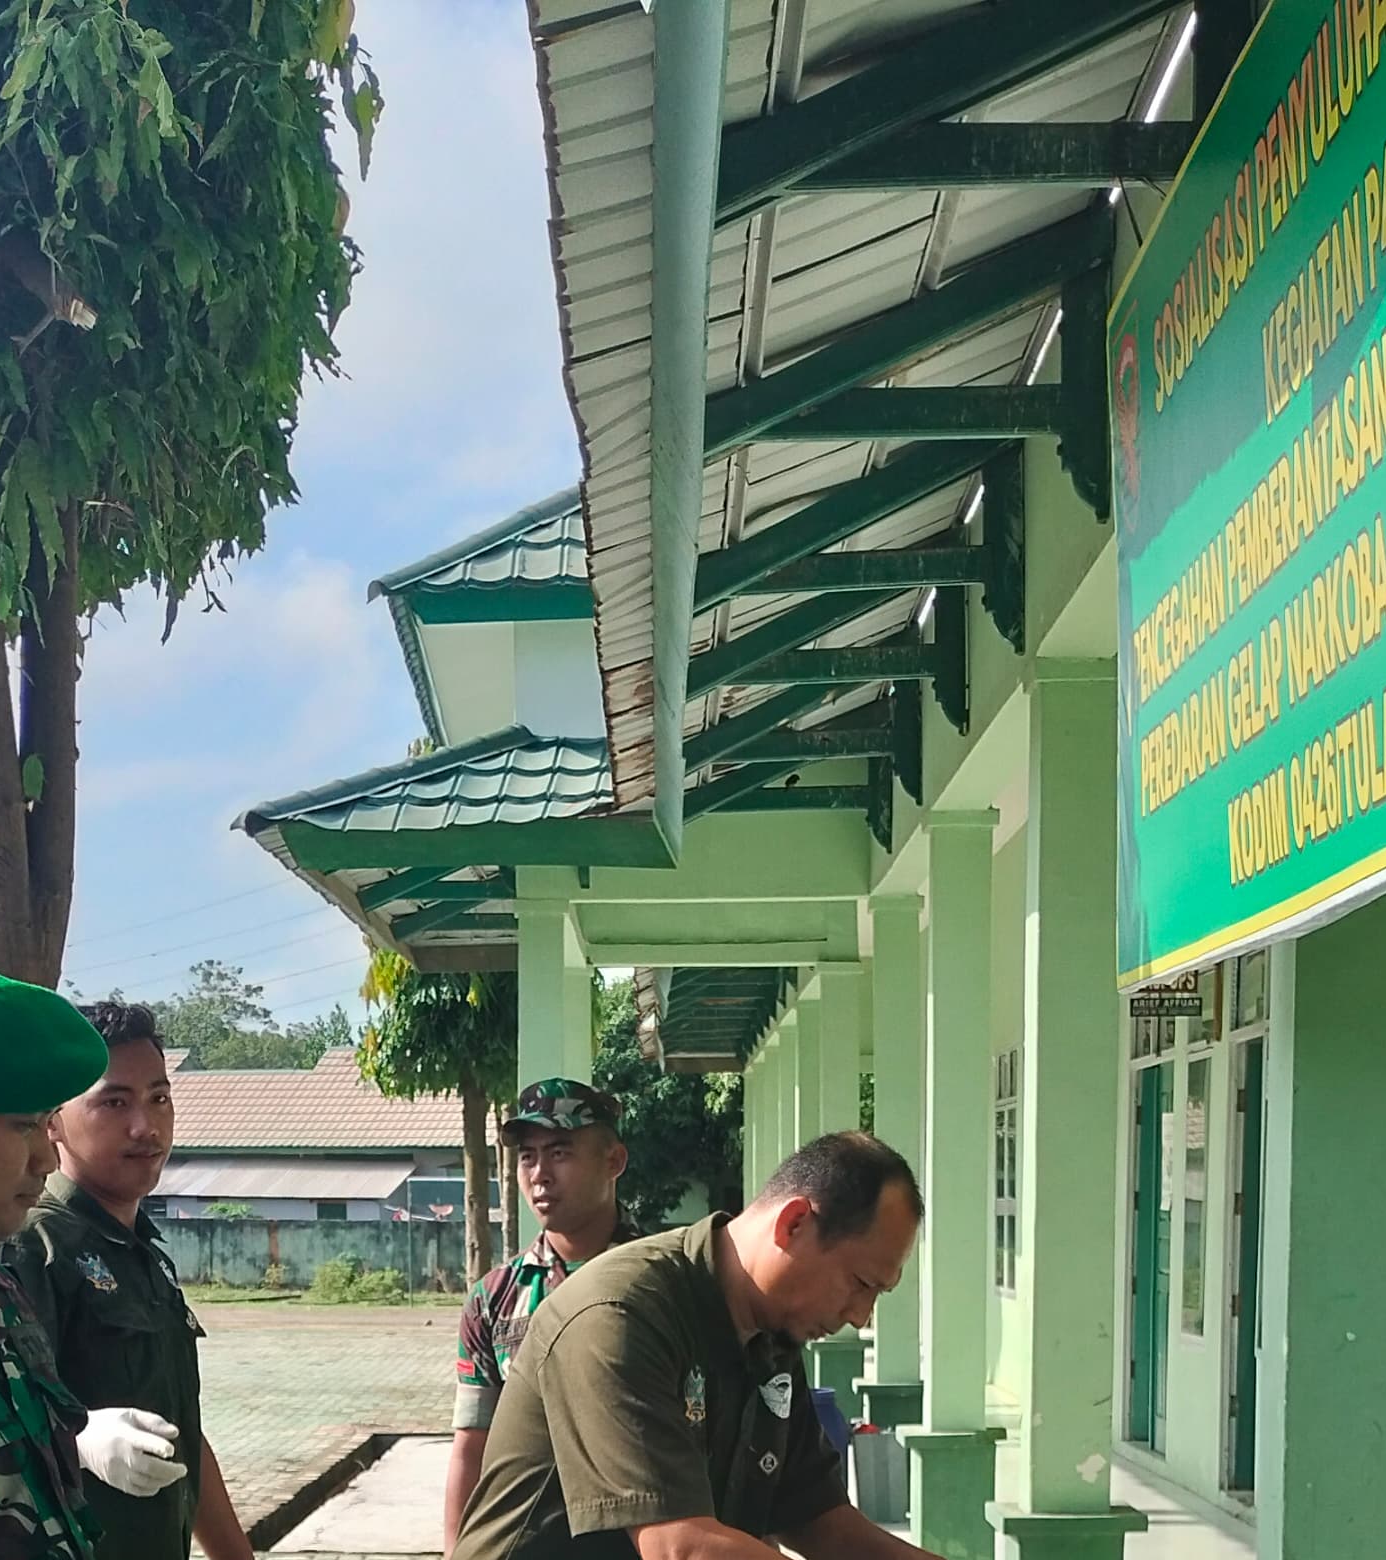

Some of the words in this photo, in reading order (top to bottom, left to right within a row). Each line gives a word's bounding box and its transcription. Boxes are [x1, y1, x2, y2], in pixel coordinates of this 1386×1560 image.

[1154, 163, 1254, 412] SOSIALISASI
[1262, 188, 1364, 426] KEGIATAN
[1140, 667, 1227, 817] PEREDARAN
[1226, 614, 1283, 750] GELAP
[1227, 763, 1290, 886] KODIM
